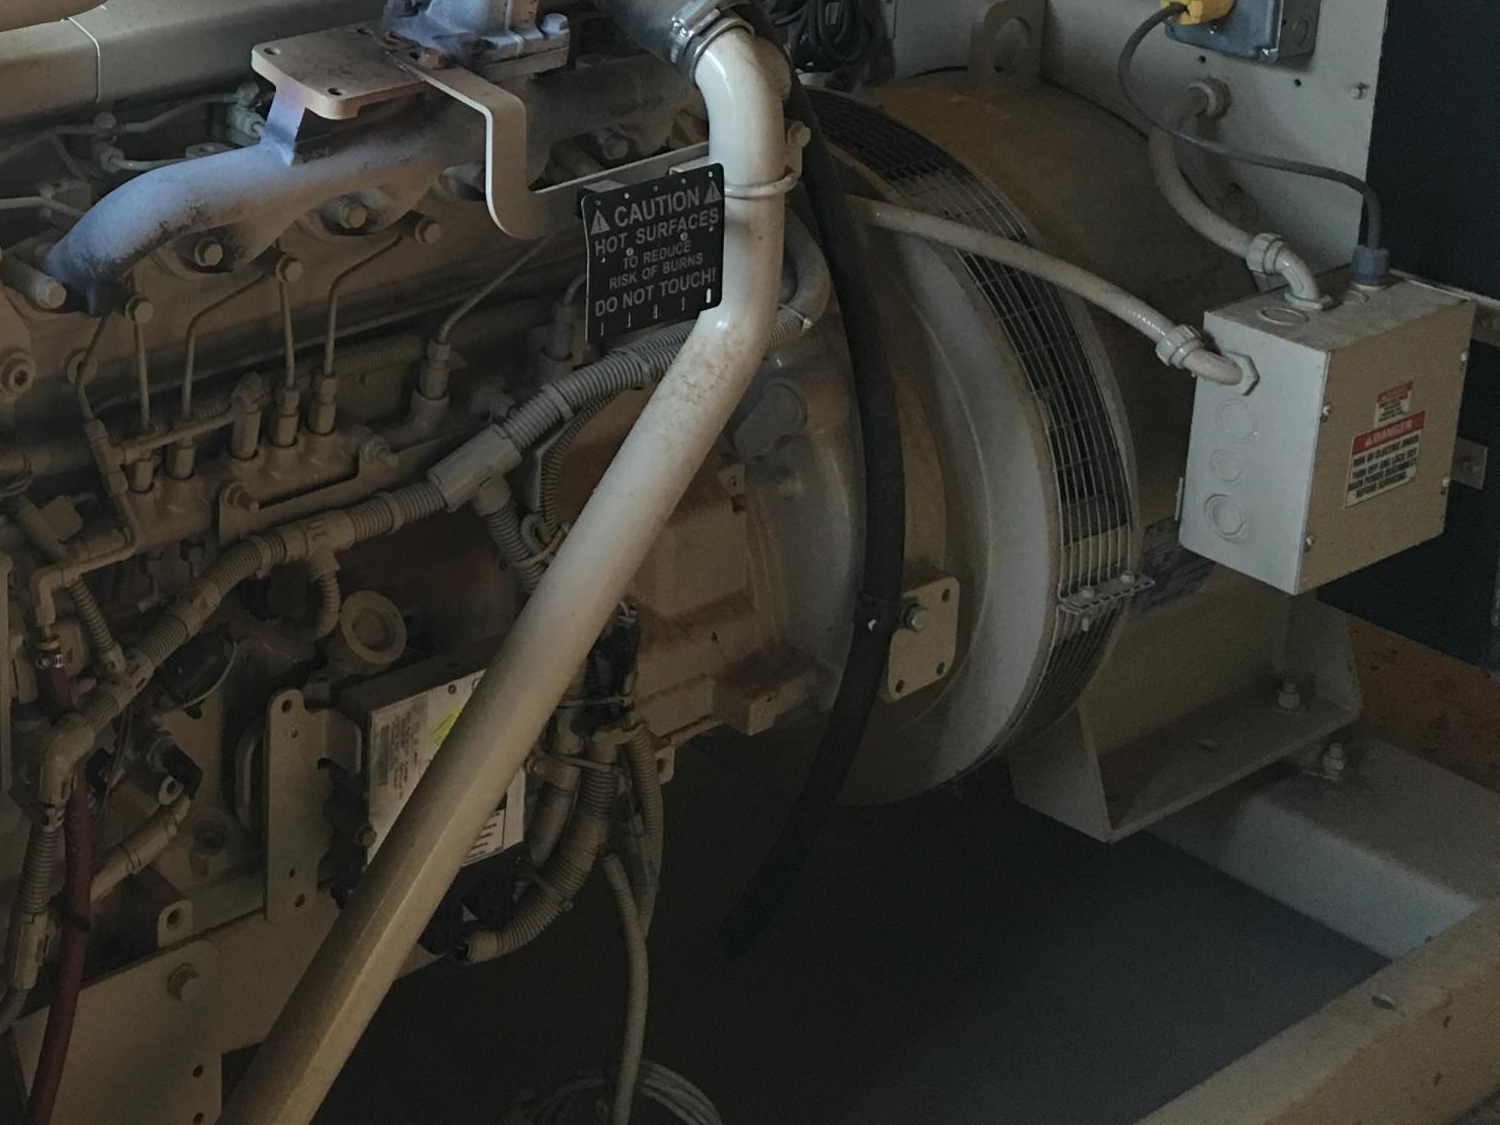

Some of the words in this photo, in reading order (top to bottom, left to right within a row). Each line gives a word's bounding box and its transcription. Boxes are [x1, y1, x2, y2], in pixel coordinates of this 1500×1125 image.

[614, 186, 700, 228] CAUTION
[595, 232, 628, 257] HOT
[635, 208, 719, 245] SURFACES
[609, 272, 637, 290] RISK
[642, 265, 659, 280] OF
[662, 252, 703, 274] BURNS
[623, 255, 638, 270] TO
[643, 239, 692, 264] REDUCE
[595, 296, 618, 317] DO
[623, 284, 654, 309] NOT
[659, 267, 716, 297] TOUCH!
